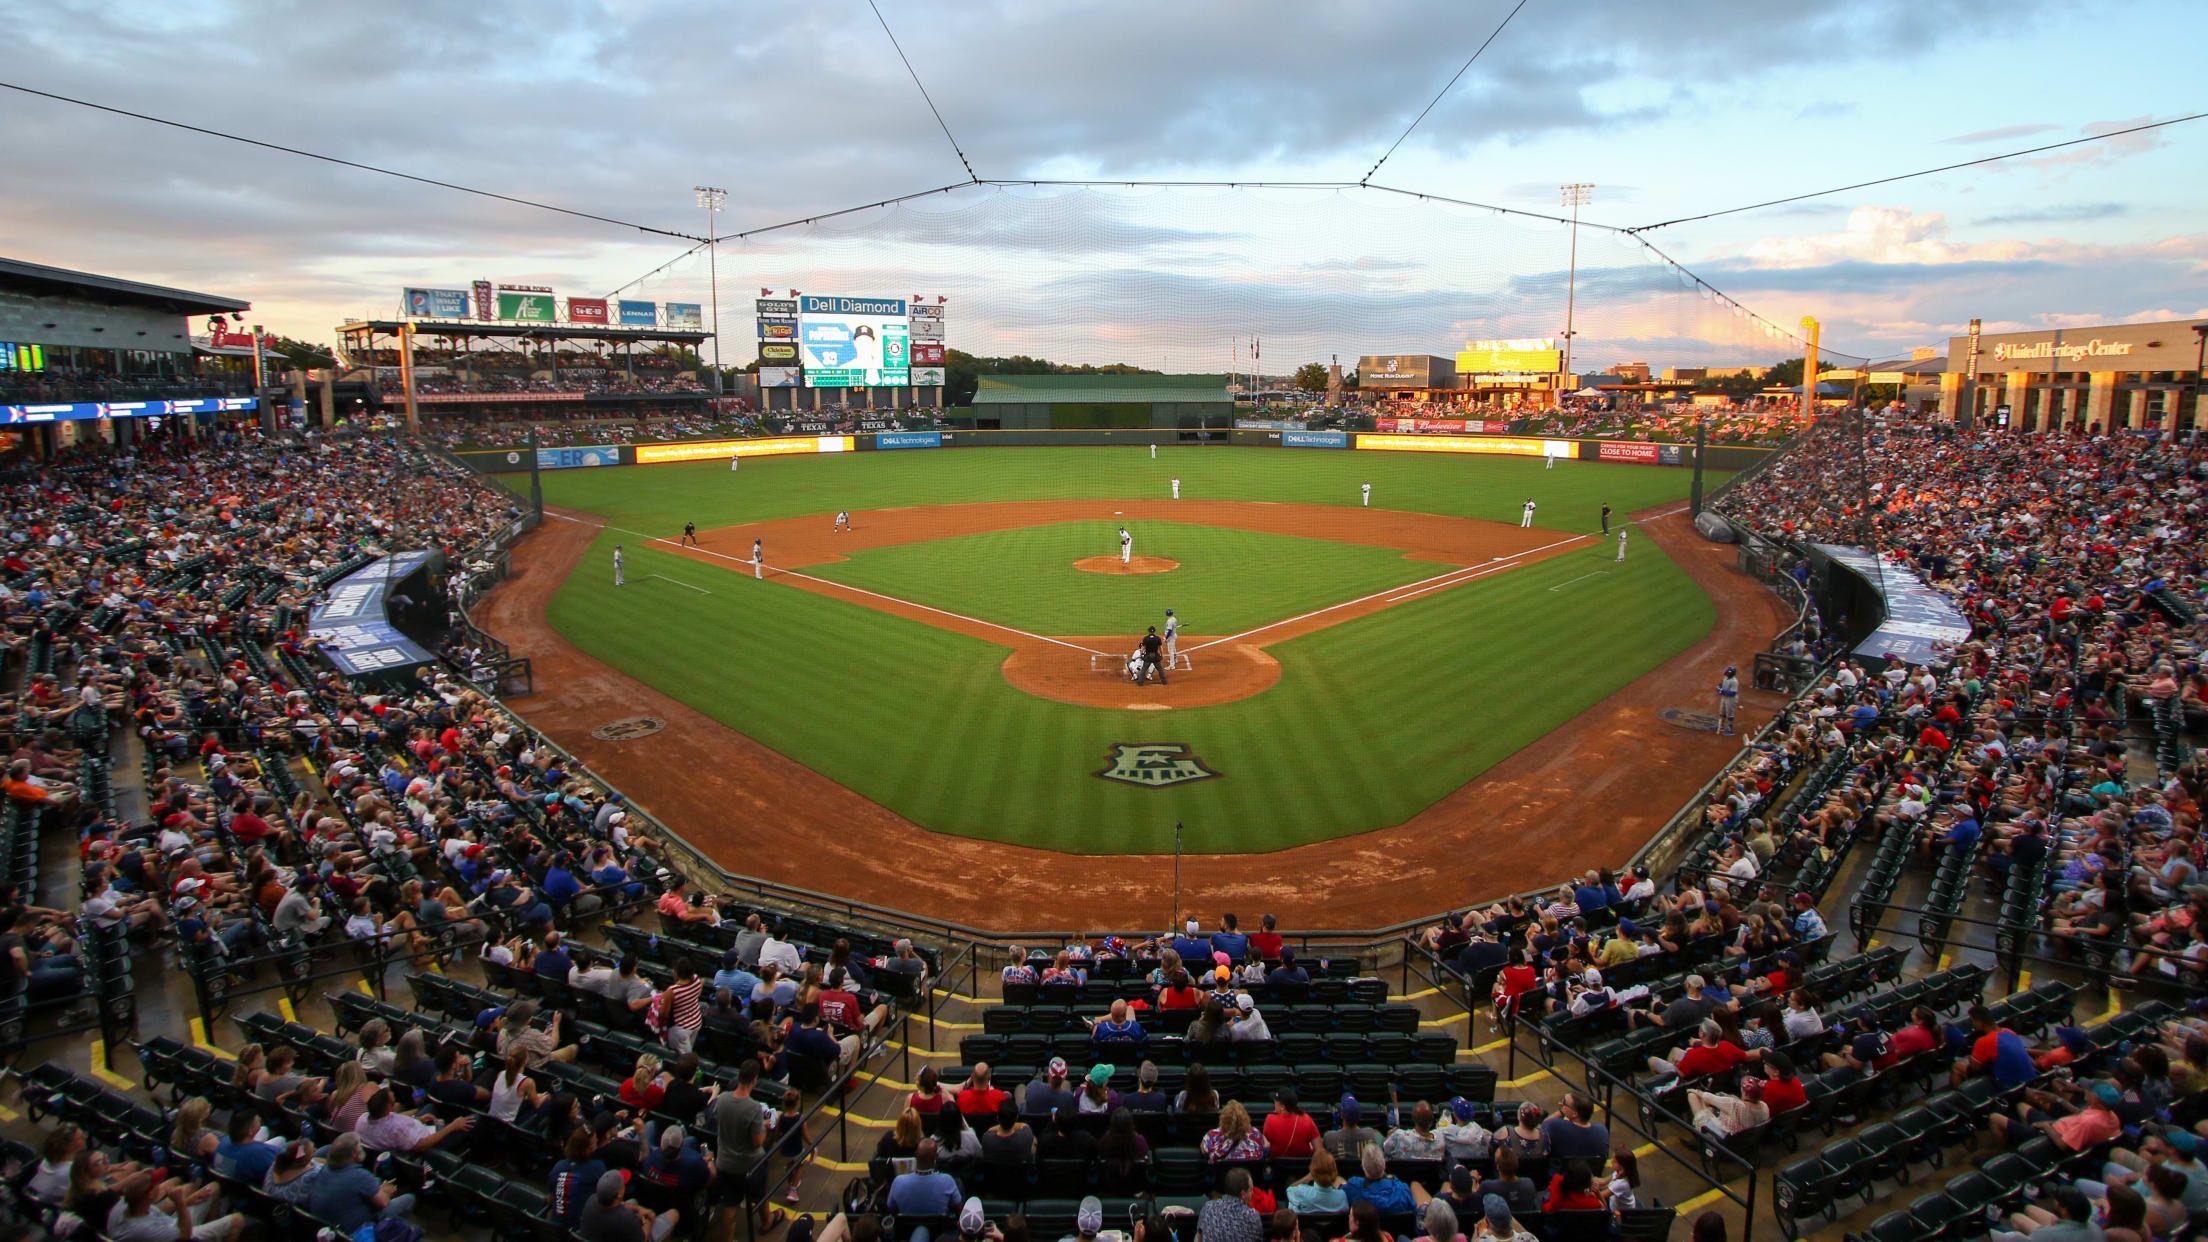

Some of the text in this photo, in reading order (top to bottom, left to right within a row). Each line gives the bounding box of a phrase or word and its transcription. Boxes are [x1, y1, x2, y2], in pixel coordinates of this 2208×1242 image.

[435, 291, 465, 299] THAT'S
[442, 305, 461, 313] LIKE
[809, 297, 899, 314] Dell Diamond
[2007, 339, 2132, 362] United Heritage Center
[1418, 420, 1462, 430] Budweiser
[901, 437, 936, 445] Technologies
[1288, 435, 1340, 445] DELL Technologies
[1600, 447, 1621, 455] CLOSE
